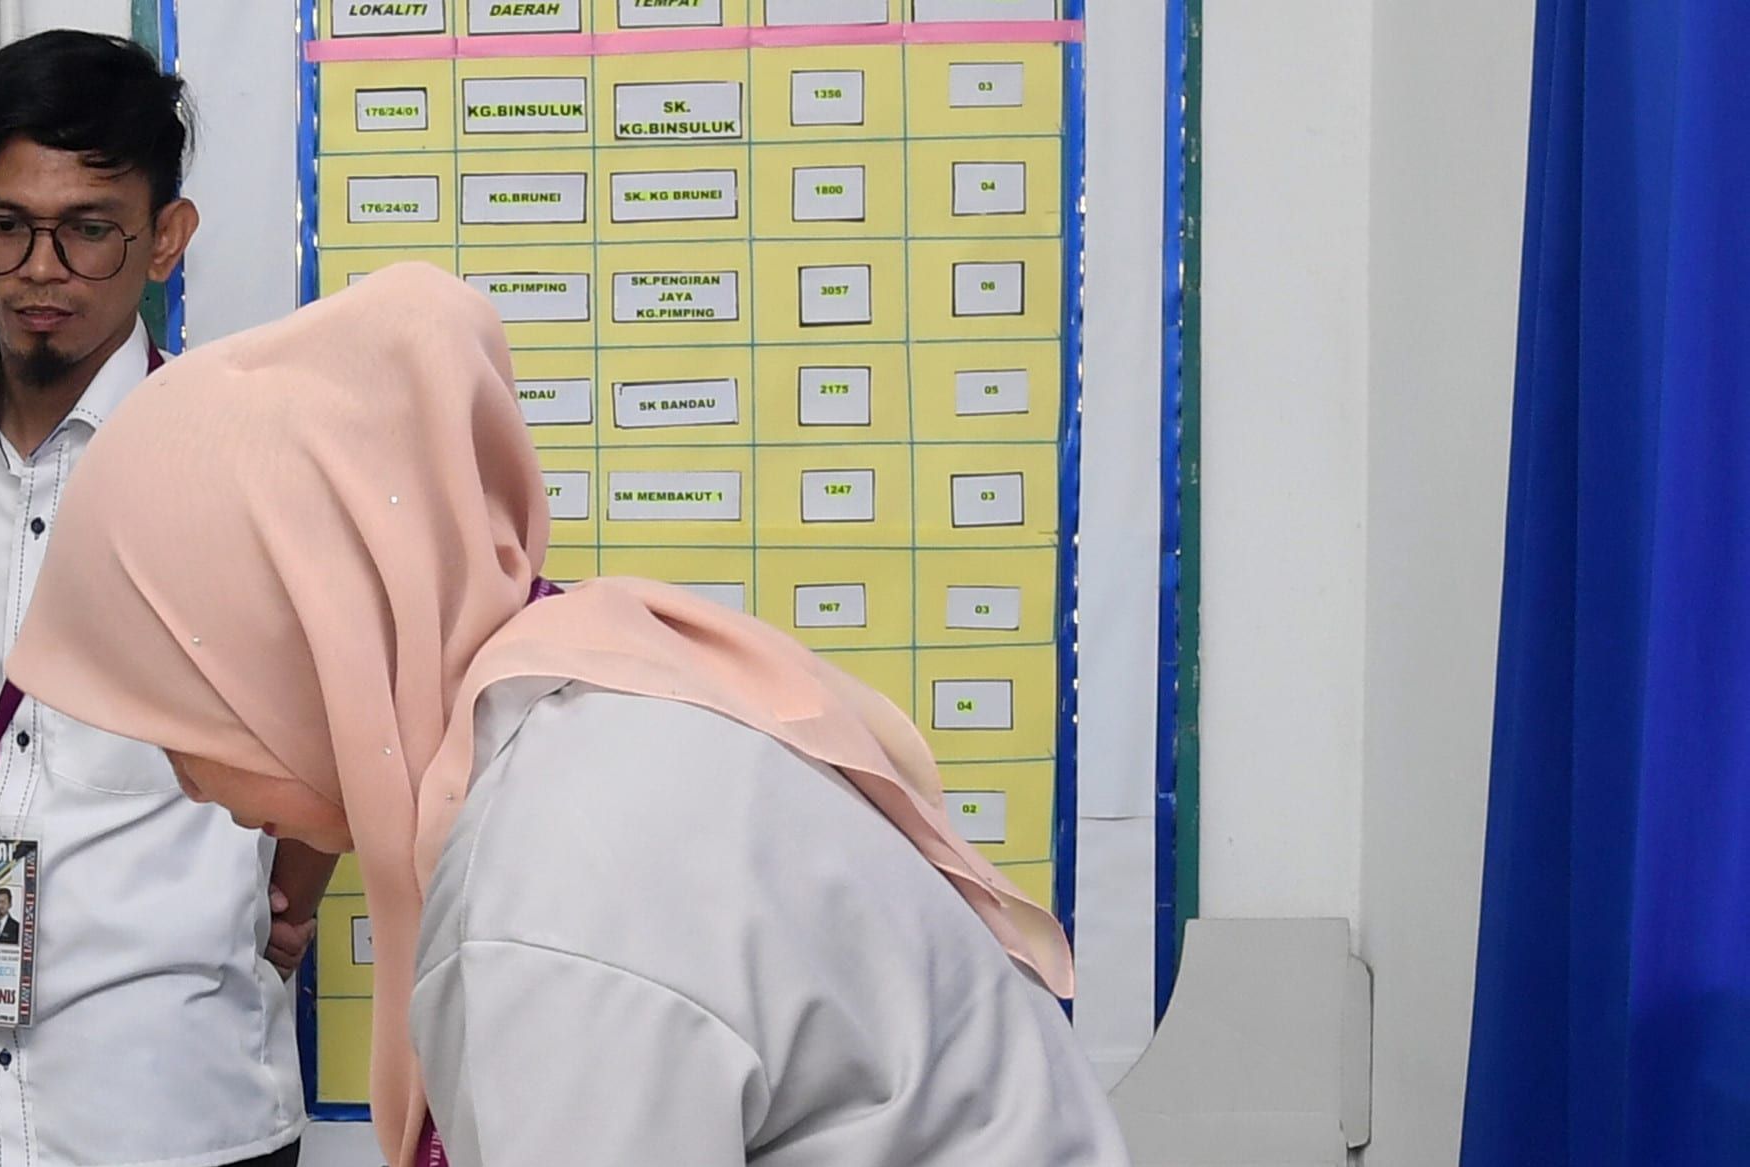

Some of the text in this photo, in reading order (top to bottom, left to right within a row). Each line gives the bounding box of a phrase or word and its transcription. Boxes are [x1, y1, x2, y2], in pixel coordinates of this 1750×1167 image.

[348, 2, 428, 17] LOKALITI
[488, 3, 560, 17] DAERAH
[977, 81, 994, 93] 03
[467, 103, 584, 118] KG.BINSULUK
[662, 101, 692, 114] SK.
[618, 120, 736, 136] KG.BINSULUK
[814, 184, 844, 196] 1800
[980, 180, 996, 192] 04
[488, 191, 562, 204] KG.BRUNEI
[623, 189, 723, 203] SK. KG BRUNEI
[359, 202, 419, 214] 176/24/02
[630, 275, 721, 287] SK.PENGIRAN
[489, 282, 568, 294] KG.PIMPING
[820, 284, 850, 297] 3057
[657, 291, 694, 303] JAYA
[635, 307, 715, 320] KG.PIMPING
[819, 382, 850, 395] 2175
[983, 384, 1000, 396] 05
[638, 398, 717, 412] SK BANDAU
[614, 491, 634, 502] SM
[636, 490, 713, 502] MEMBAKUT
[824, 483, 853, 496] 1247
[980, 490, 996, 502] 03
[818, 601, 841, 614] 967
[975, 604, 991, 616] 03
[956, 699, 973, 712] 04
[962, 803, 978, 815] 02
